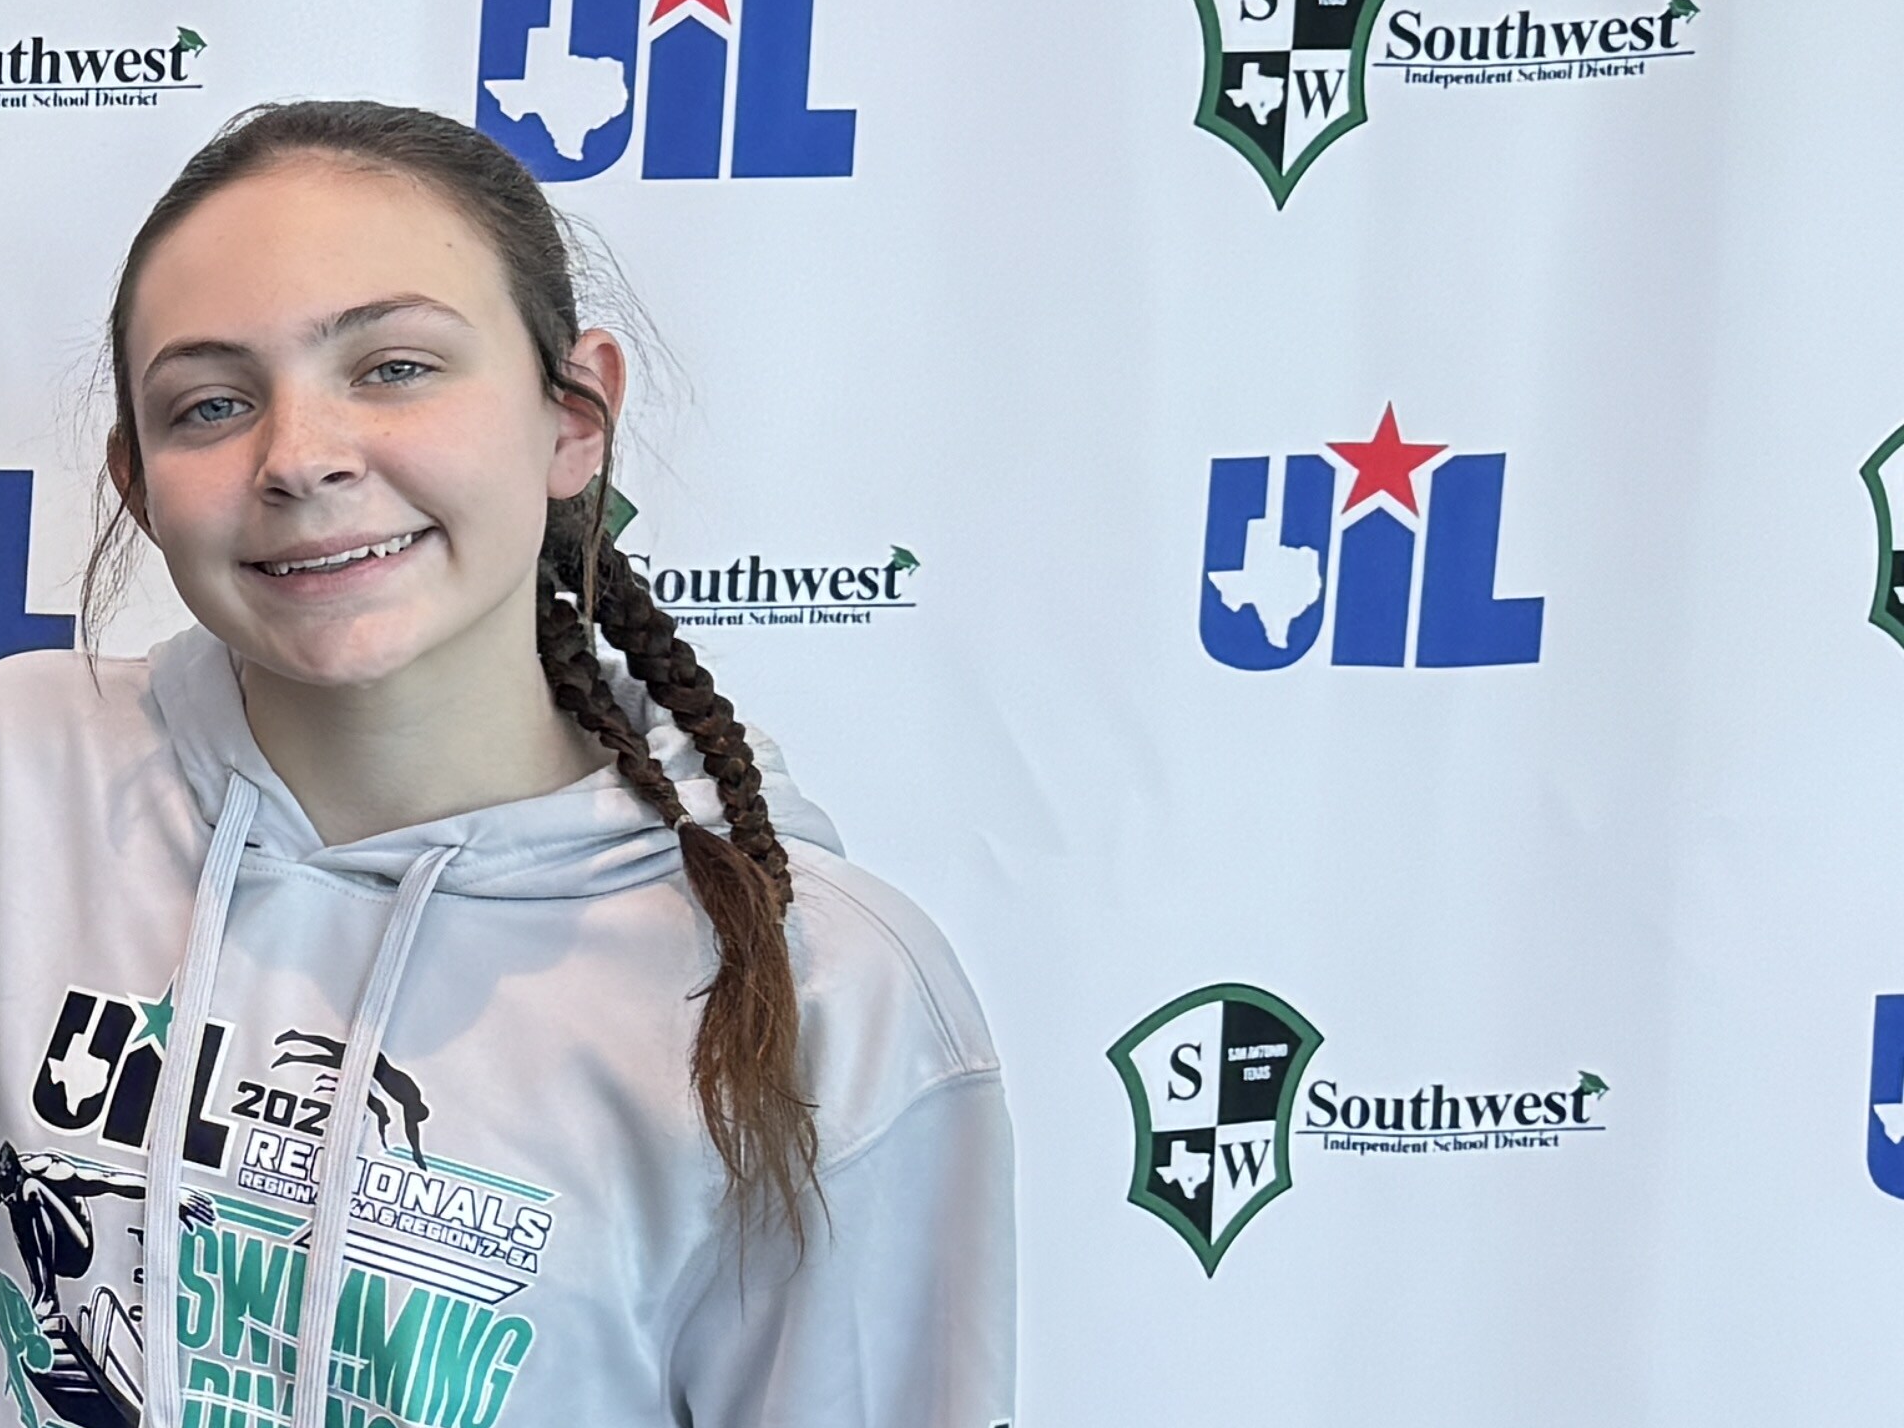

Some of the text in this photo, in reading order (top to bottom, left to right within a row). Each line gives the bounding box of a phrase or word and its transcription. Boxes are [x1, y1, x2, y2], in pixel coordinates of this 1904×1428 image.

[1294, 69, 1345, 118] W
[1167, 1041, 1204, 1102] S
[1306, 1070, 1591, 1131] Southwest
[231, 1080, 333, 1137] 202
[1220, 1139, 1271, 1188] W
[238, 1167, 312, 1203] REGION
[396, 1212, 479, 1253] REGION
